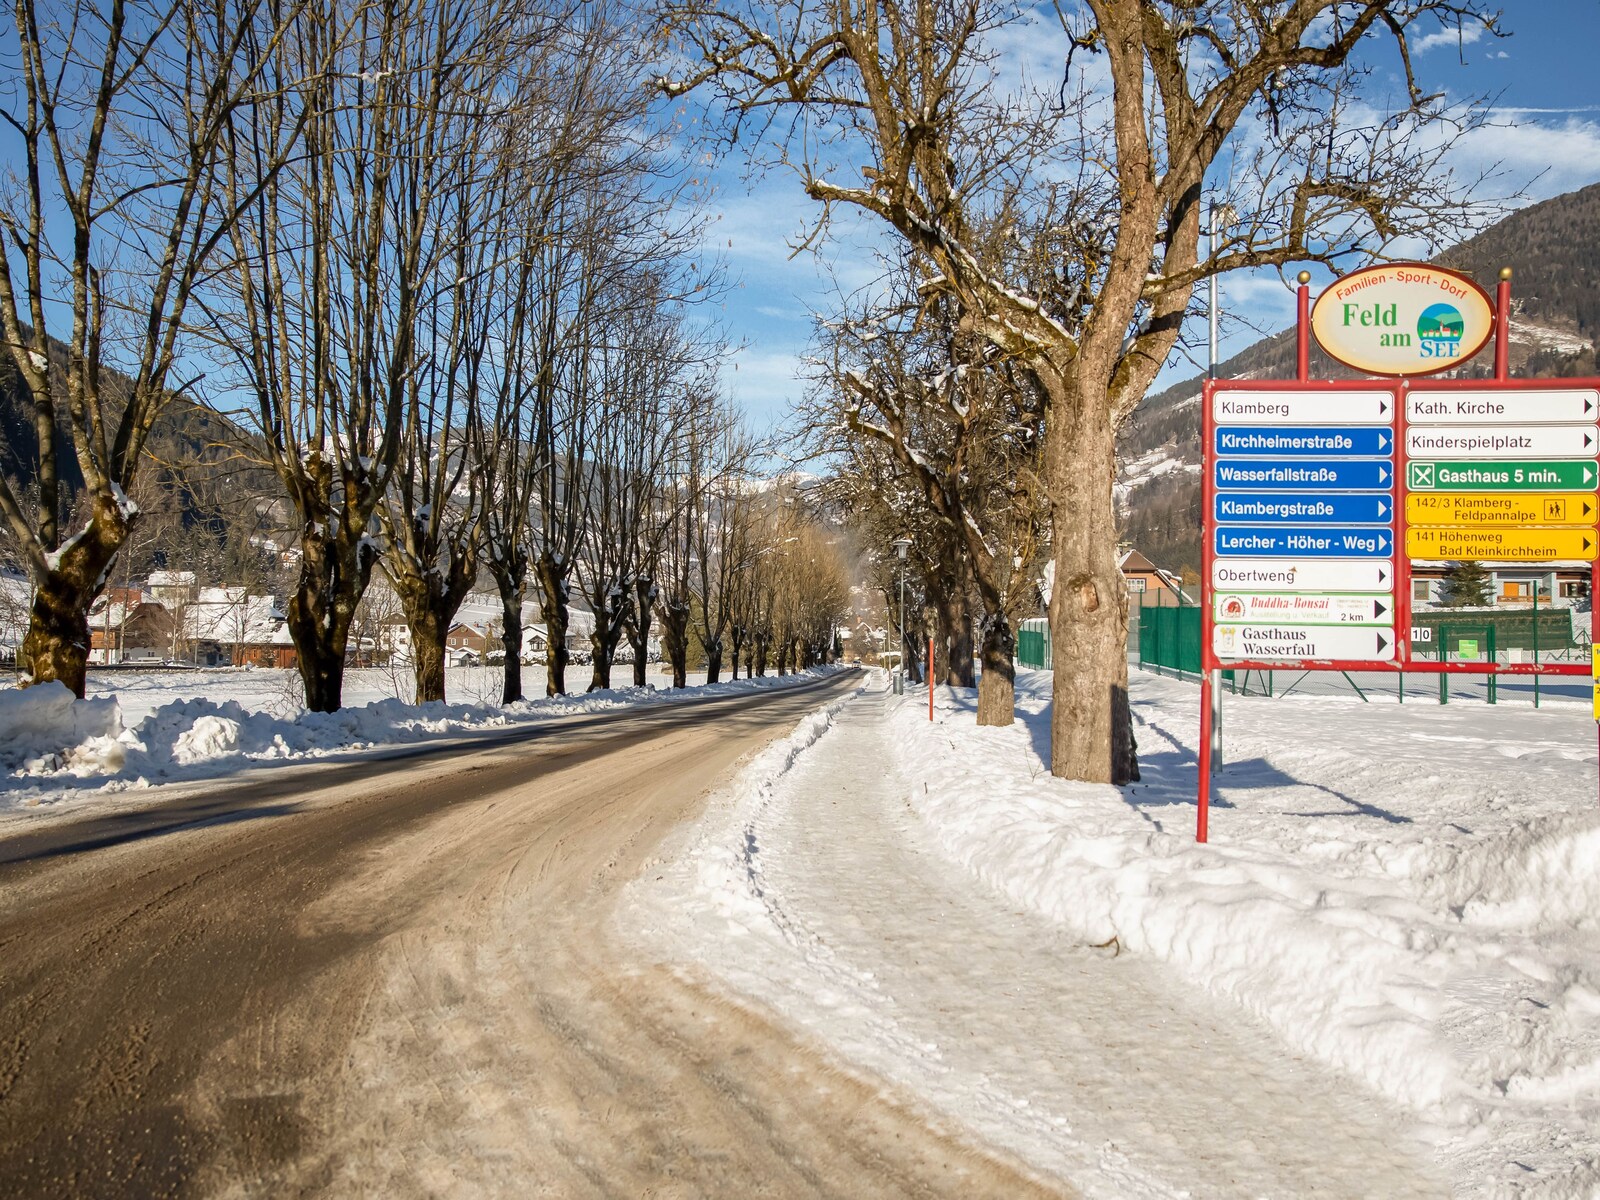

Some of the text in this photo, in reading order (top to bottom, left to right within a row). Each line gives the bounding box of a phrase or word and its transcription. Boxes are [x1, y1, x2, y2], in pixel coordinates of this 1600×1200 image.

[1336, 273, 1386, 300] Familien
[1396, 271, 1431, 285] Sport
[1439, 279, 1468, 300] Dorf
[1342, 303, 1397, 327] Feld
[1380, 333, 1411, 347] am
[1419, 341, 1460, 358] SEE
[1222, 402, 1289, 416] Klamberg
[1415, 401, 1505, 414] Kath. Kirche
[1221, 434, 1353, 449] Kirchheimerstraße
[1412, 435, 1532, 450] Kinderspielplatz
[1220, 467, 1337, 482] Wasserfallstraße
[1439, 469, 1562, 483] Gasthaus 5 min.
[1221, 501, 1334, 518] Klambergstraße
[1416, 498, 1450, 508] 142/3
[1454, 497, 1512, 509] Klamberg
[1454, 511, 1537, 522] Feldpannalpe
[1221, 534, 1276, 549] Lercher
[1287, 535, 1331, 549] Höher
[1343, 536, 1376, 552] Weg
[1416, 532, 1503, 544] 141 Höhenweg
[1440, 545, 1557, 556] Bad Kleinkirchheim
[1218, 568, 1295, 585] Obertweng
[1251, 597, 1330, 609] Buddha-Bonsai
[1341, 613, 1364, 621] 2 km
[1242, 627, 1306, 641] Gasthaus
[1243, 643, 1316, 656] Wasserfall
